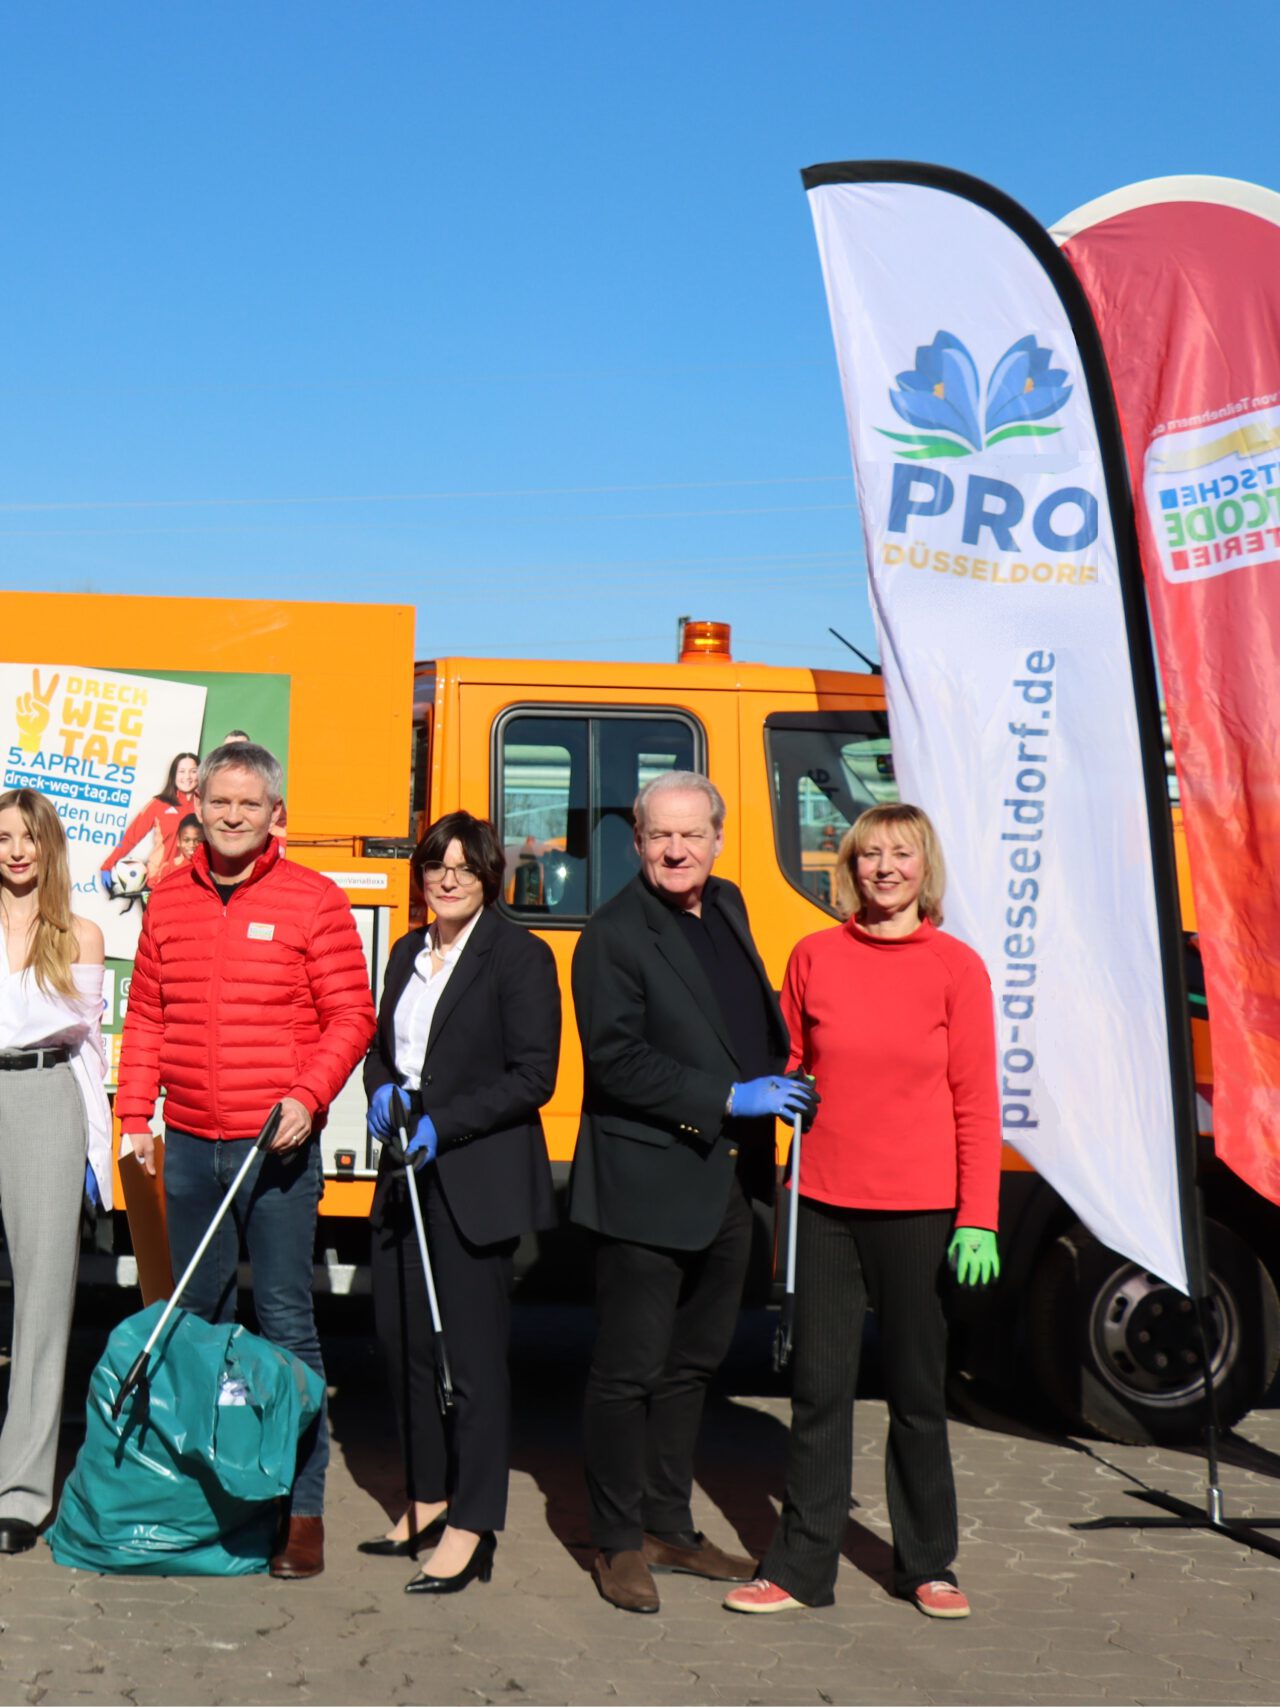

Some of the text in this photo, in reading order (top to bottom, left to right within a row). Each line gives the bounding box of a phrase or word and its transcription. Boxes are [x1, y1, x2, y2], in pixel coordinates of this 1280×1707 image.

[887, 462, 1099, 553] PRO
[882, 542, 1097, 585] DÜSSELDORF
[66, 676, 149, 706] DRECK
[62, 697, 144, 738] WEG
[7, 746, 136, 784] 5. APRIL 25
[59, 728, 138, 768] TAG
[5, 771, 130, 804] dreck-weg-tag.de
[94, 812, 128, 828] und
[1002, 650, 1056, 1129] pro-duesseldorf.de
